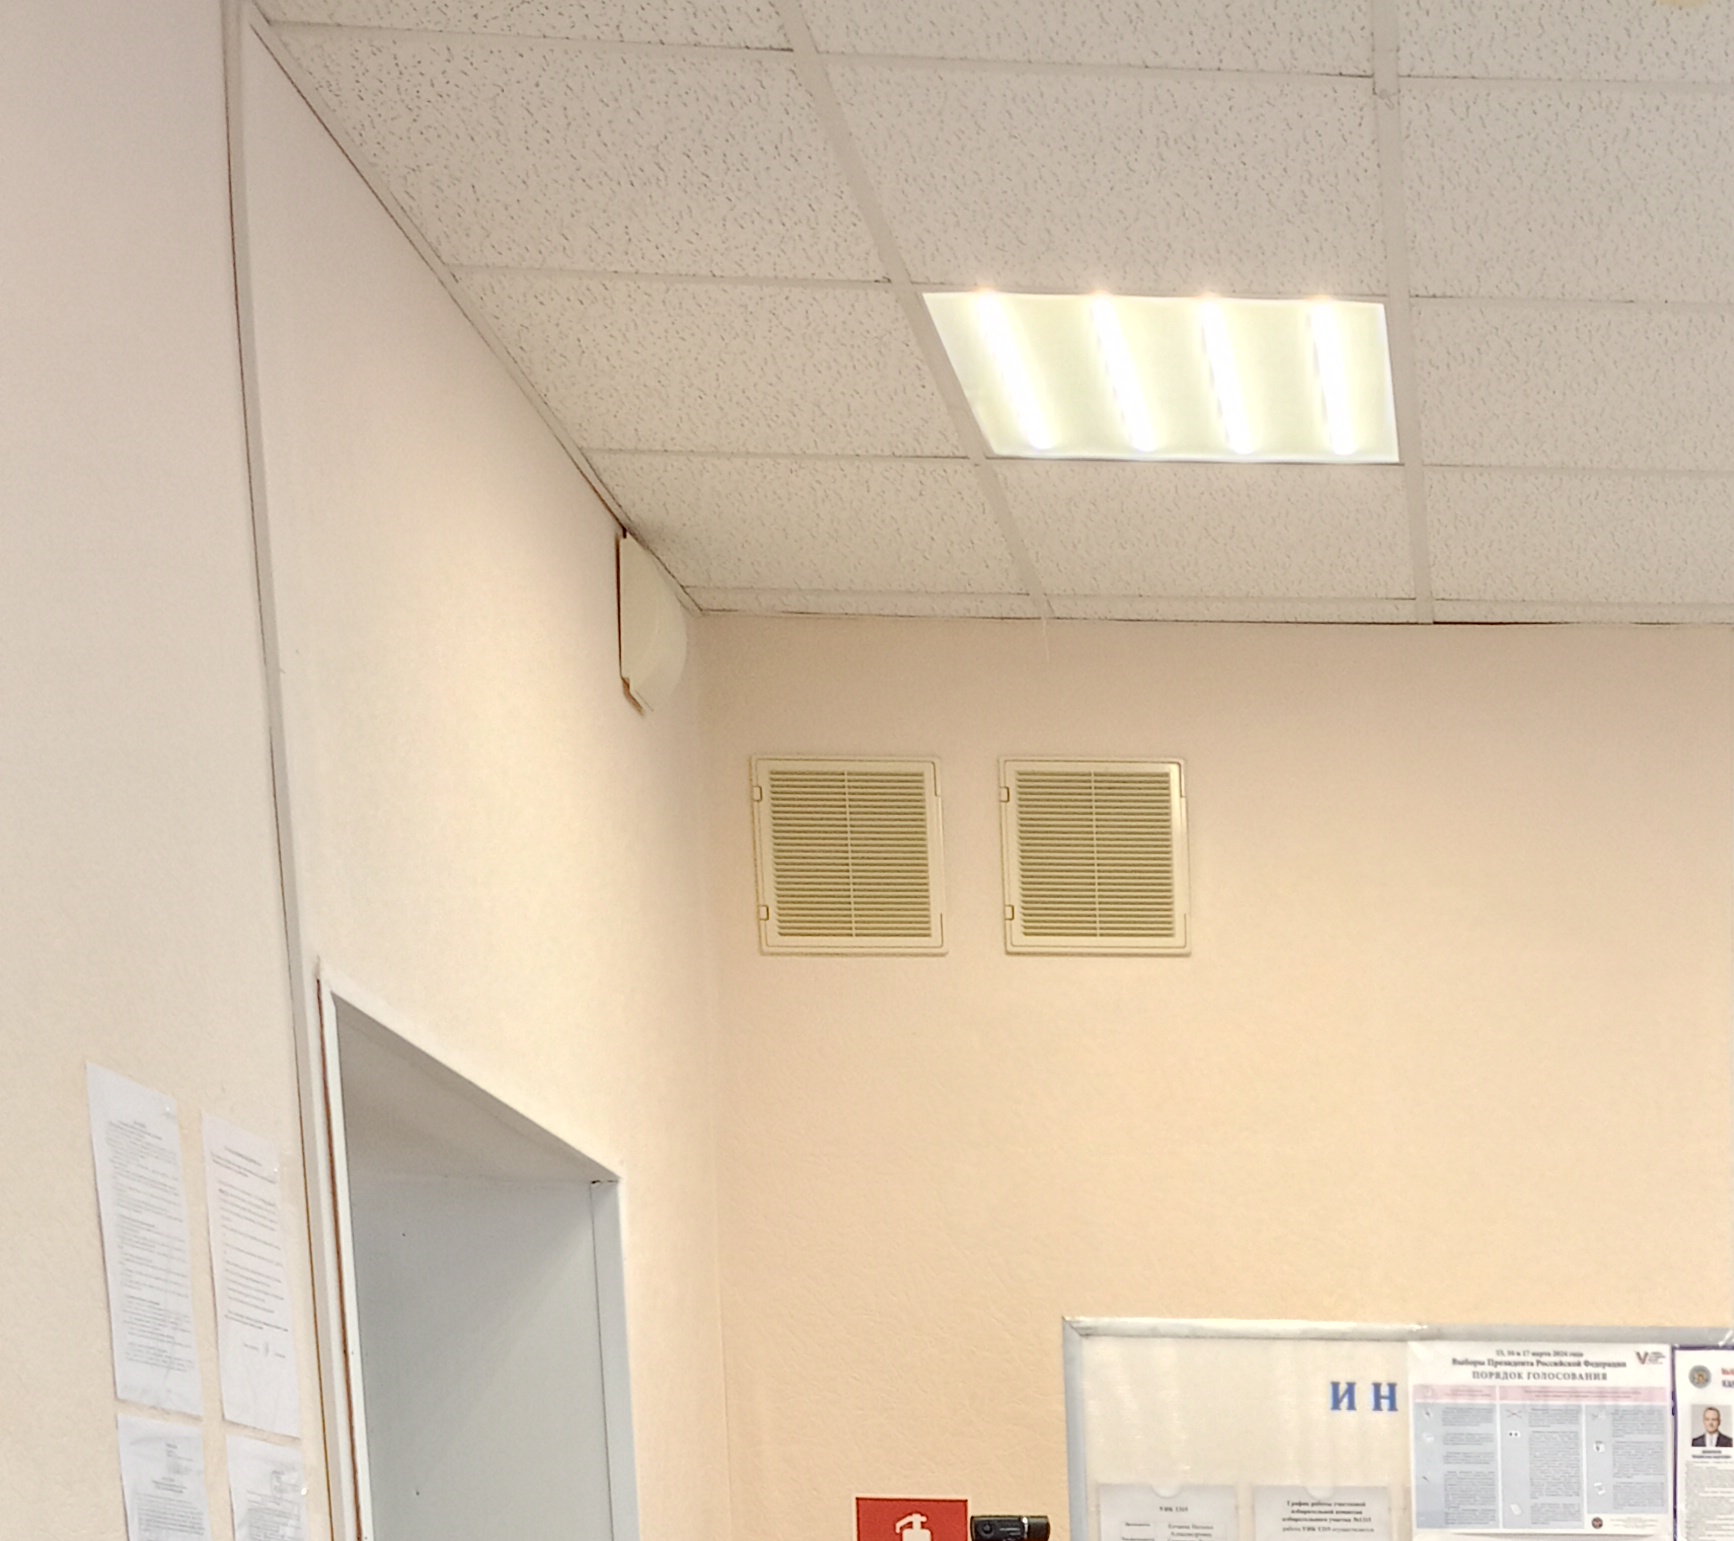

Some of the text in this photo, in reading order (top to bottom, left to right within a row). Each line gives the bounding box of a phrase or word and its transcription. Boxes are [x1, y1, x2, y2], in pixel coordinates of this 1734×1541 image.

[1452, 1358, 1627, 1369] Выборы Президента Российской Федерации
[1472, 1371, 1608, 1381] ПОРЯДОК ГОЛОСОВАНИЯ
